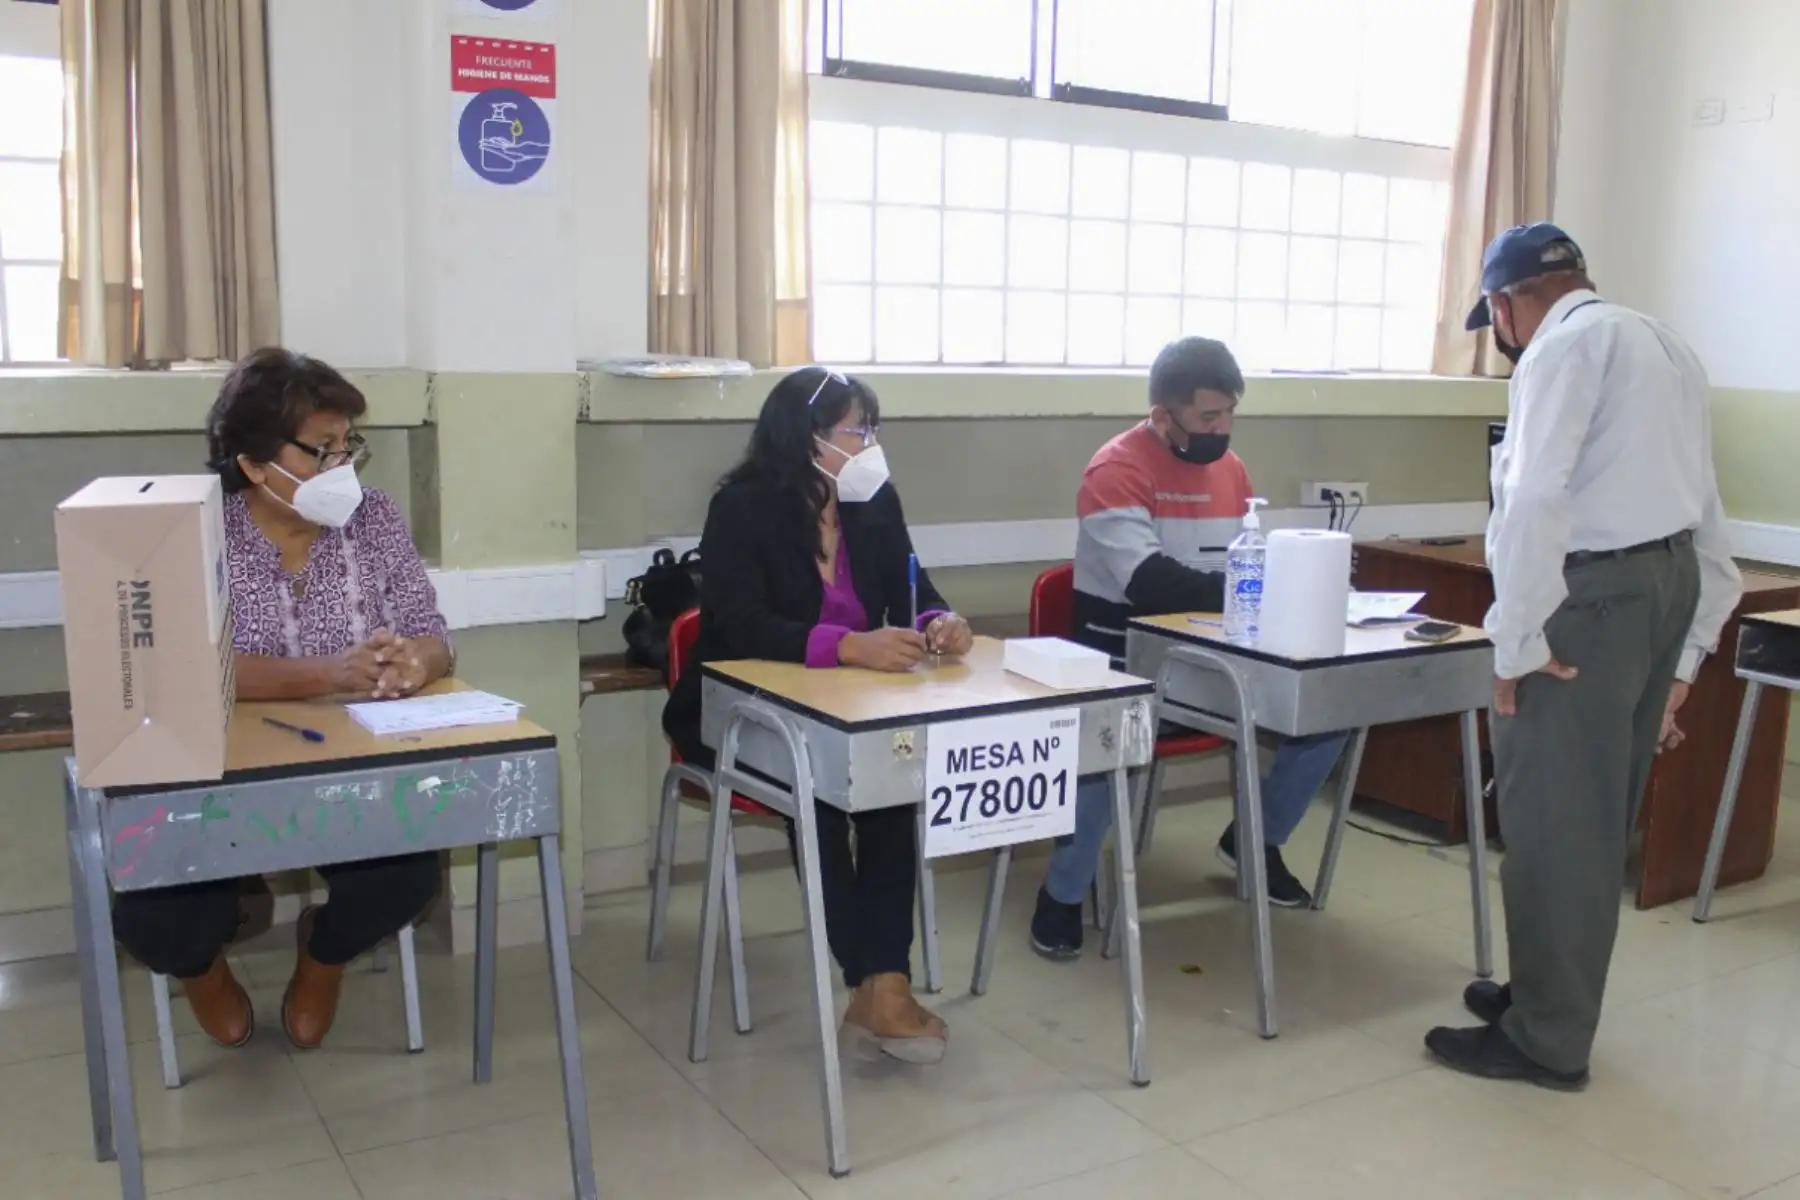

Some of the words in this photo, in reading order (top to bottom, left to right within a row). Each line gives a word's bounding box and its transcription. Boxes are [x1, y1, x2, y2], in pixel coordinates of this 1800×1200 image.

[458, 67, 497, 79] HIGIENE
[499, 71, 512, 80] DE
[514, 72, 550, 84] MANOS
[475, 55, 532, 69] FRECUENTE
[121, 651, 134, 710] ELECTORALES
[946, 741, 1025, 774] MESA
[930, 768, 1067, 827] 278001
